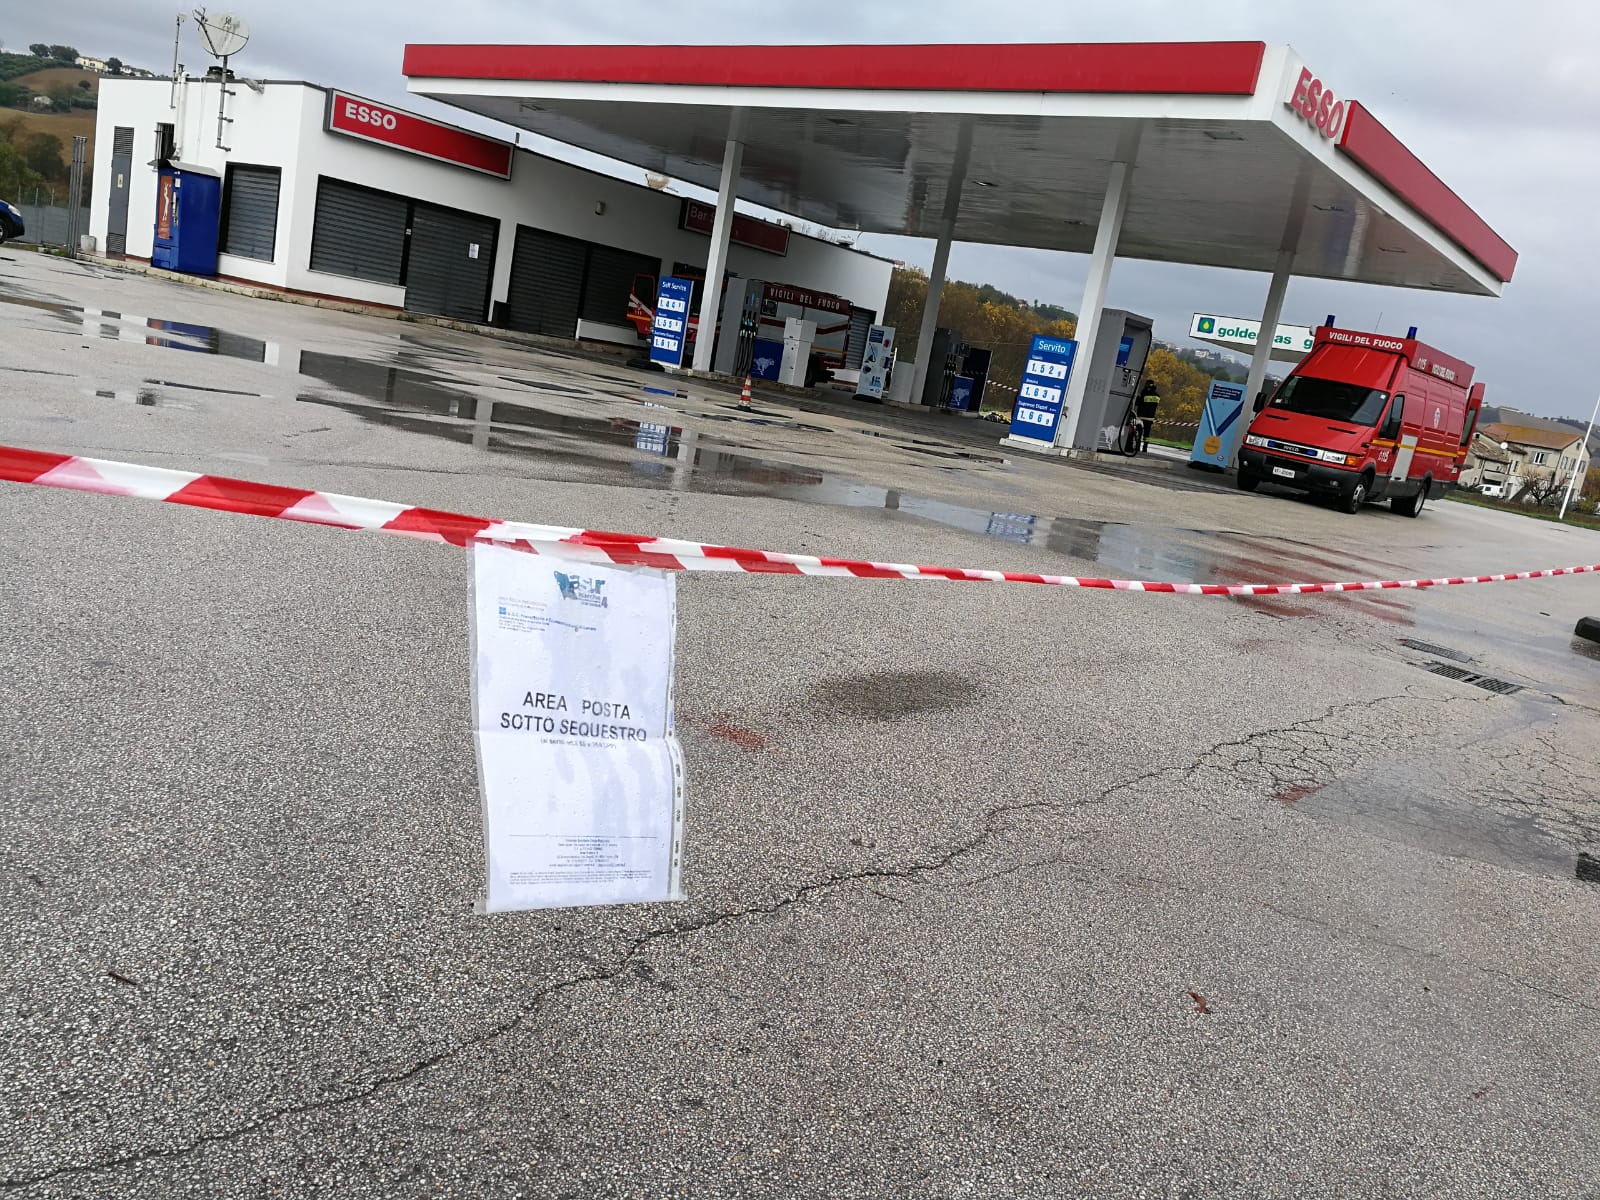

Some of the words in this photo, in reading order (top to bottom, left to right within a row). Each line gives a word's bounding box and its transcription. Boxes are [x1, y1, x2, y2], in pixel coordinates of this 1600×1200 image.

[1290, 65, 1344, 139] ESSO
[345, 101, 397, 130] ESSO
[690, 205, 707, 221] Bar
[672, 283, 687, 292] Service
[770, 287, 794, 301] VIGILI
[800, 294, 812, 304] DEL
[817, 298, 840, 310] FUOCO
[1038, 340, 1066, 353] Servito
[1217, 327, 1292, 345] goldeas
[1329, 331, 1353, 342] VIGILI
[1354, 336, 1371, 345] DEL
[1373, 339, 1403, 350] FUOCO
[522, 691, 568, 711] AREA
[581, 699, 631, 720] POSTA
[500, 712, 555, 733] SOTTO
[559, 719, 647, 742] SEQUESTRO
